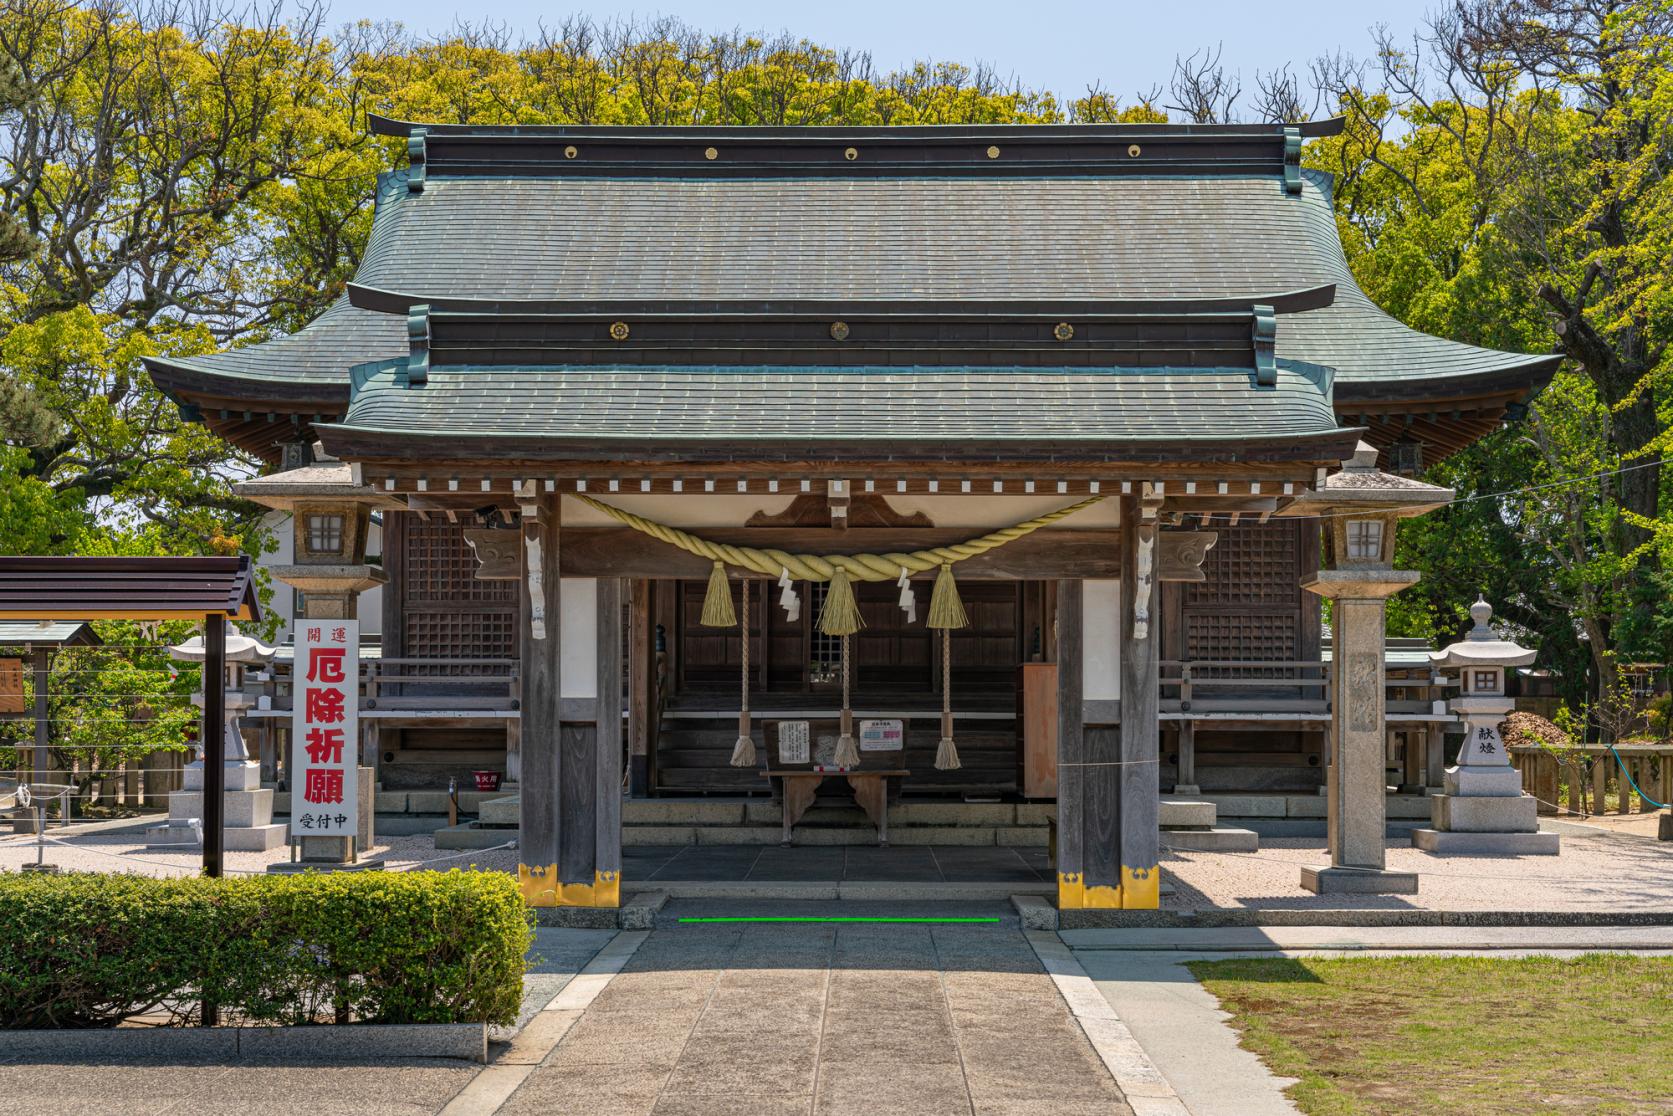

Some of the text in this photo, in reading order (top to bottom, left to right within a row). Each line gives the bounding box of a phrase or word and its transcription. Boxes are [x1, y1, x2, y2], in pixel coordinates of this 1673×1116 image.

[307, 627, 347, 643] 開運
[304, 647, 346, 805] 厄除祈願
[300, 813, 348, 829] 受付中
